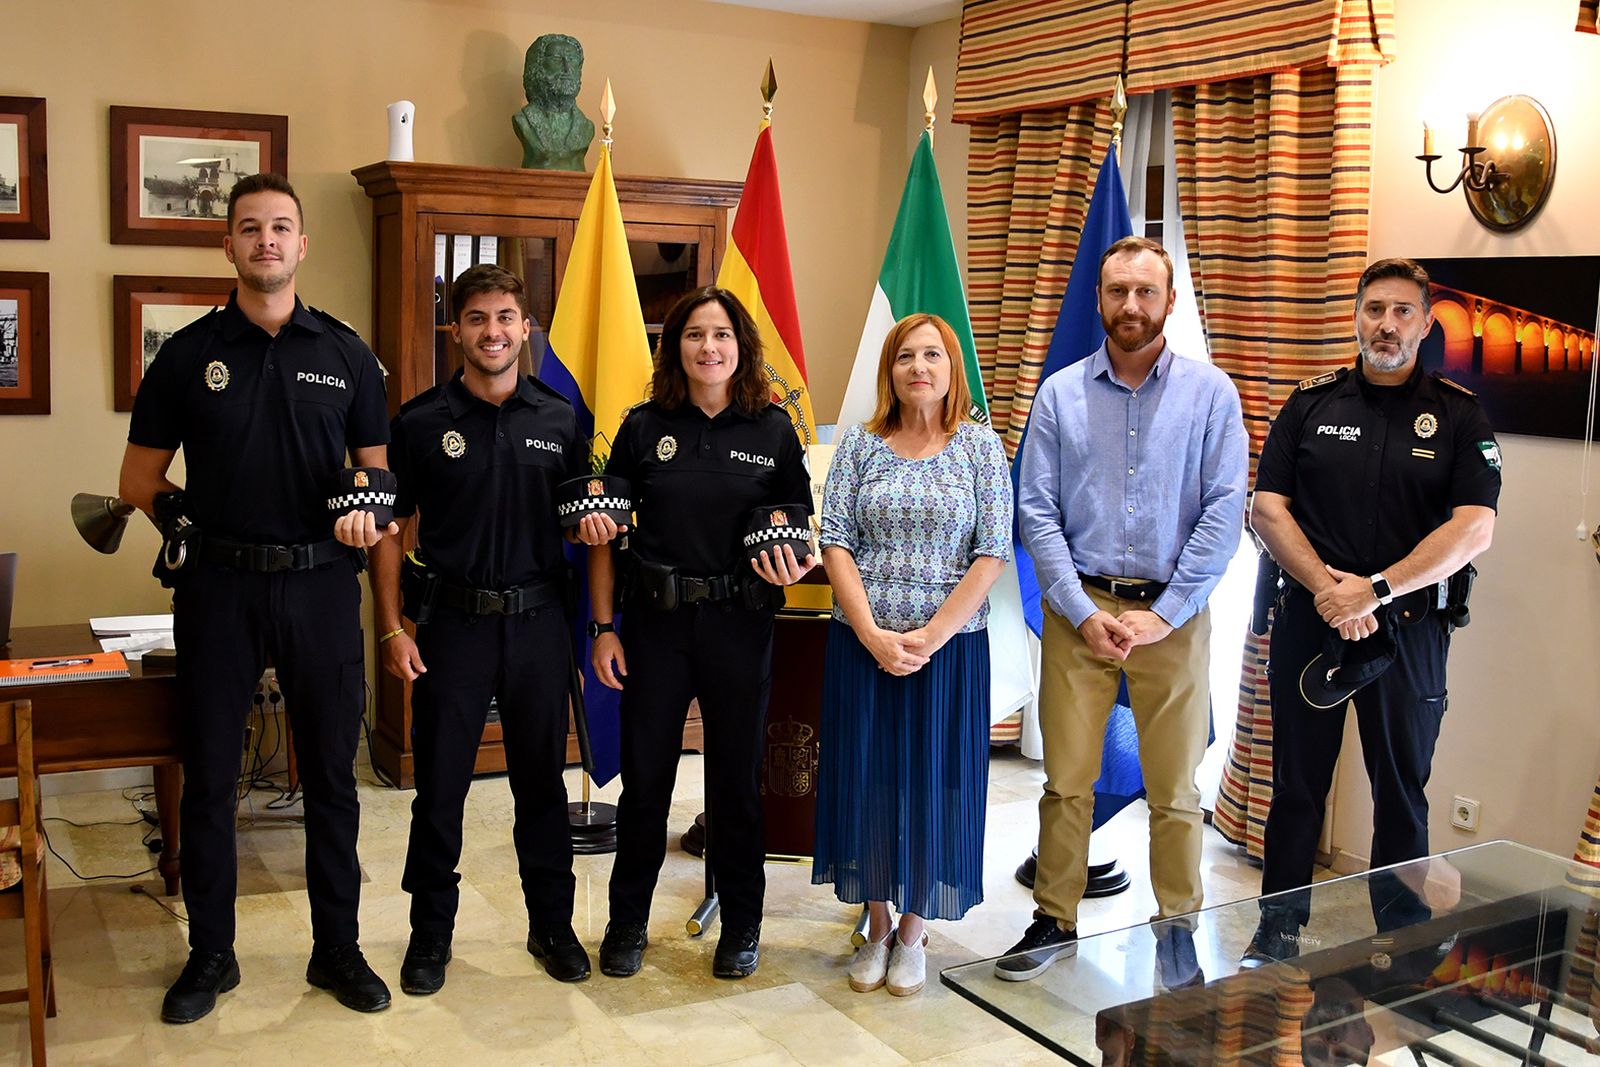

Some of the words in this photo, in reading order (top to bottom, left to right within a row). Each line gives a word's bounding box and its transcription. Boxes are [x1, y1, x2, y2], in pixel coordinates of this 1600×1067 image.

[296, 371, 347, 390] POLICIA
[1316, 425, 1361, 437] POLICIA
[1338, 434, 1358, 442] LOCAL
[525, 438, 563, 455] POLICIA
[730, 450, 775, 468] POLICIA
